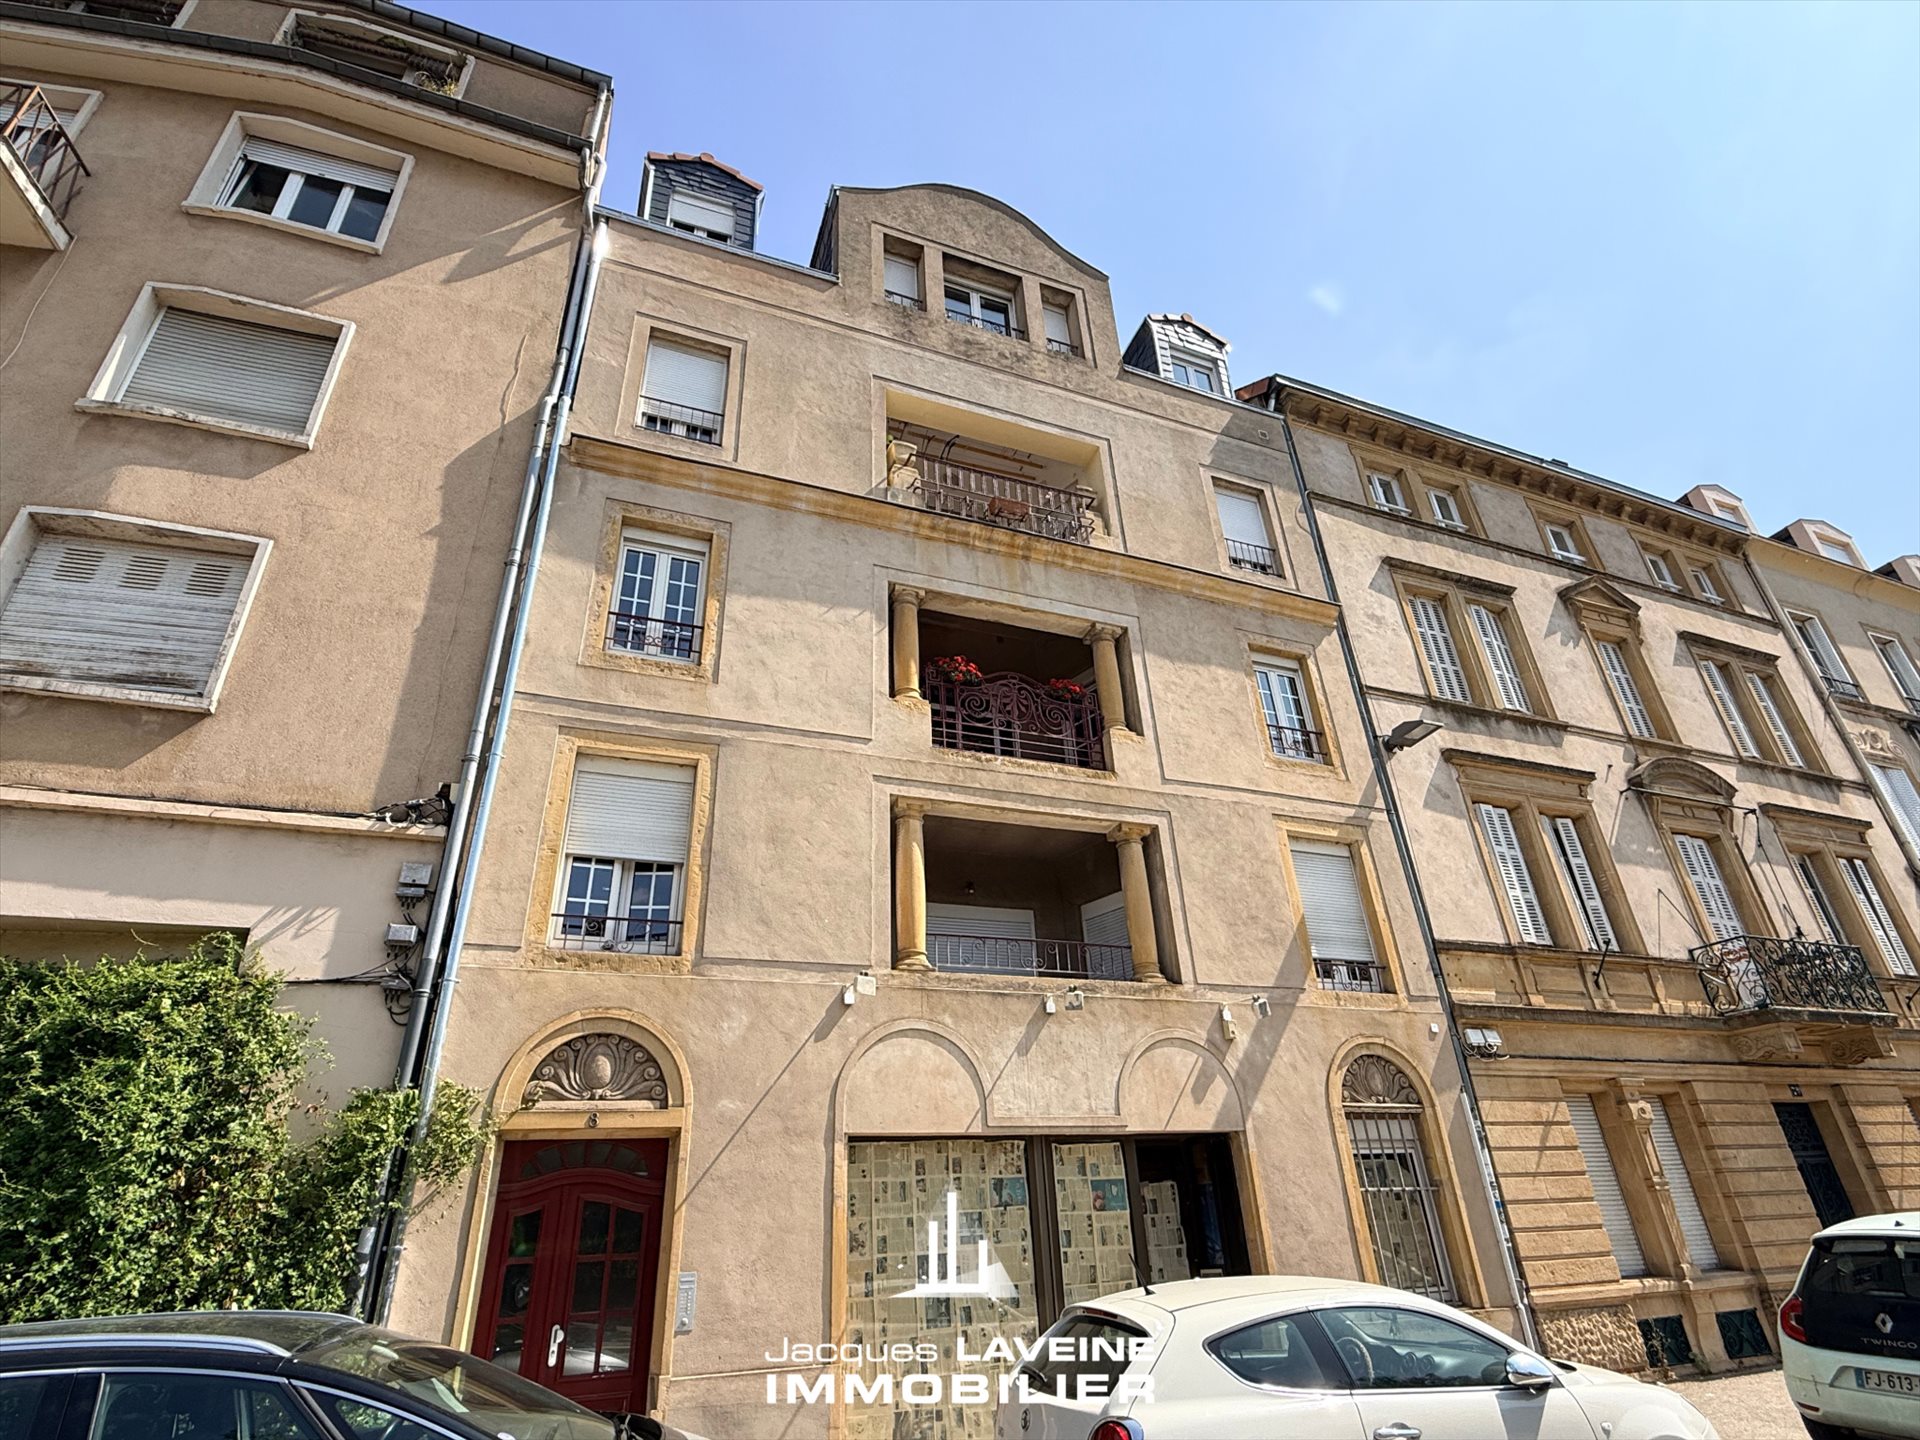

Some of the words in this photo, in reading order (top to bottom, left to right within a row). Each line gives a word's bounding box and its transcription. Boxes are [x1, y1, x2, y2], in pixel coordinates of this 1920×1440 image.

[589, 1112, 600, 1128] 8
[1861, 1337, 1918, 1350] TWINGO
[1864, 1371, 1920, 1392] FJ-613-
